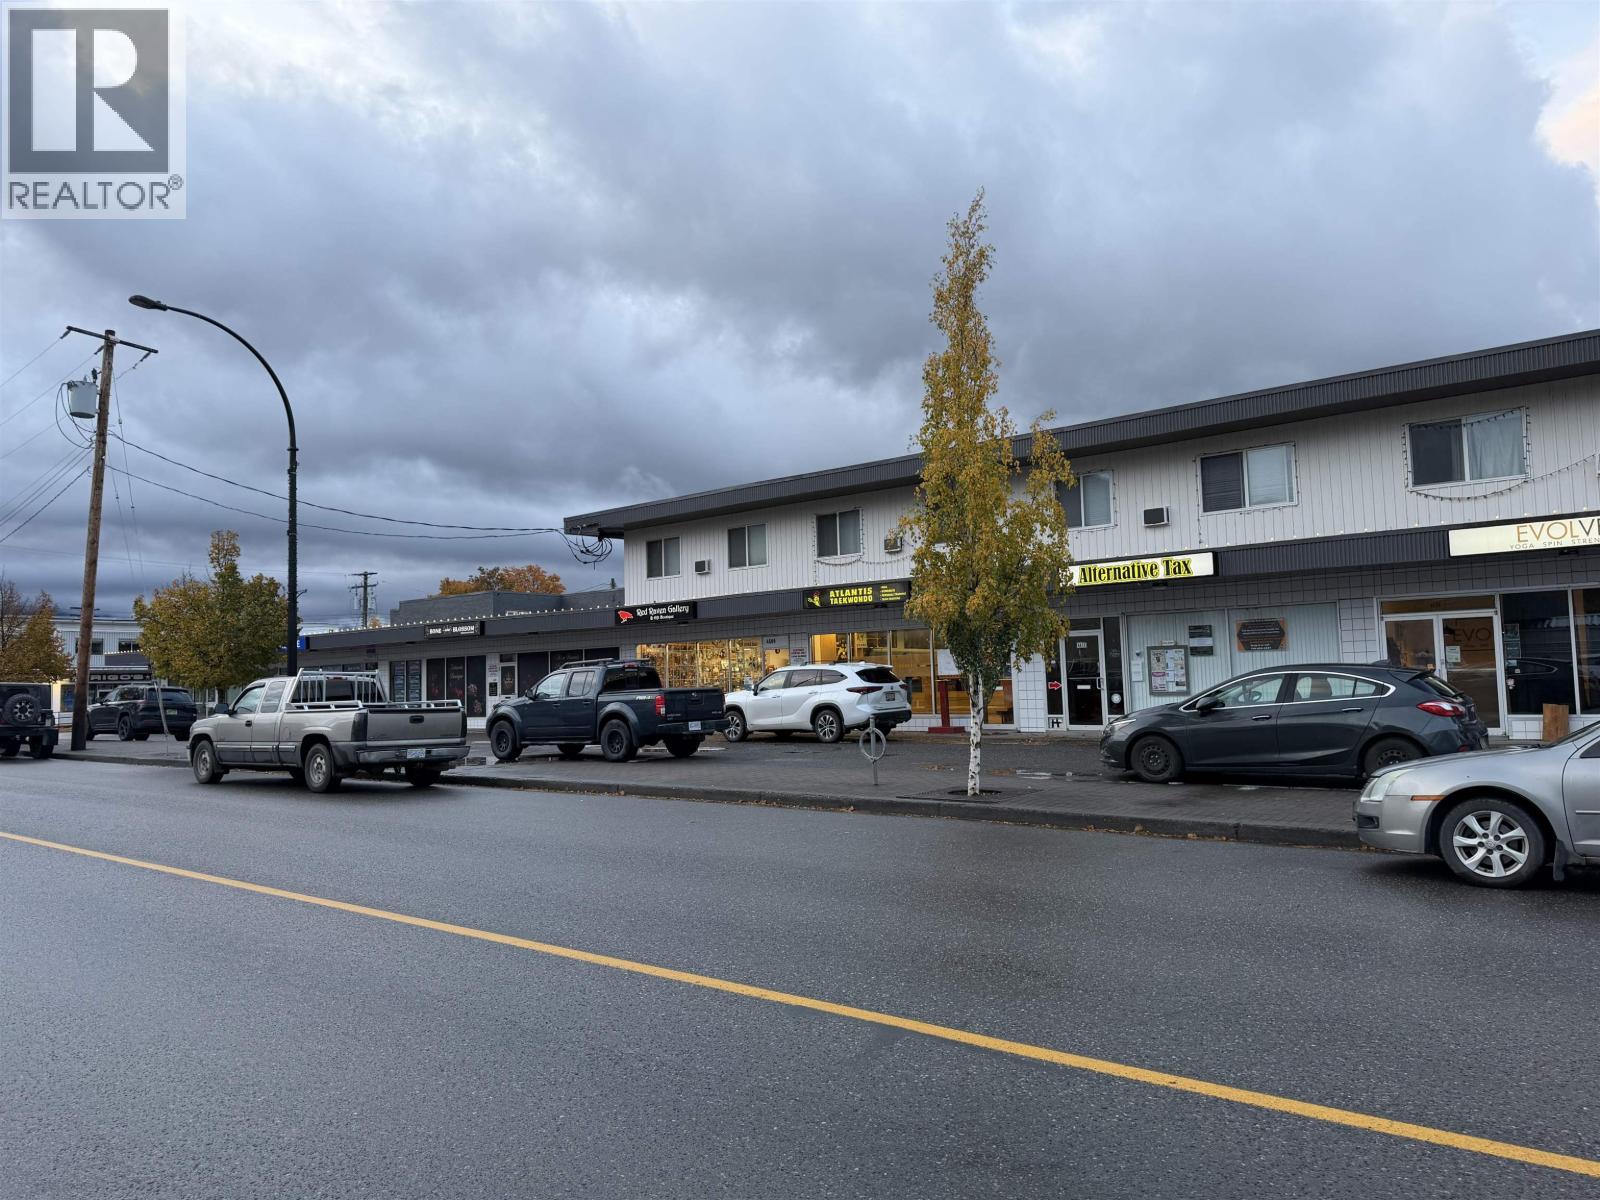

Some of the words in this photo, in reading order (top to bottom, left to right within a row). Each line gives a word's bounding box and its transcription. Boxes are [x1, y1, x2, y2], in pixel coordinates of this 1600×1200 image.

[1079, 560, 1159, 584] Alternative
[1162, 557, 1192, 577] Tax
[829, 586, 873, 598] ATLANTIS
[830, 595, 873, 605] TAEKWONDO
[636, 608, 648, 617] Red
[649, 607, 667, 616] Raven
[667, 604, 690, 614] Gallery
